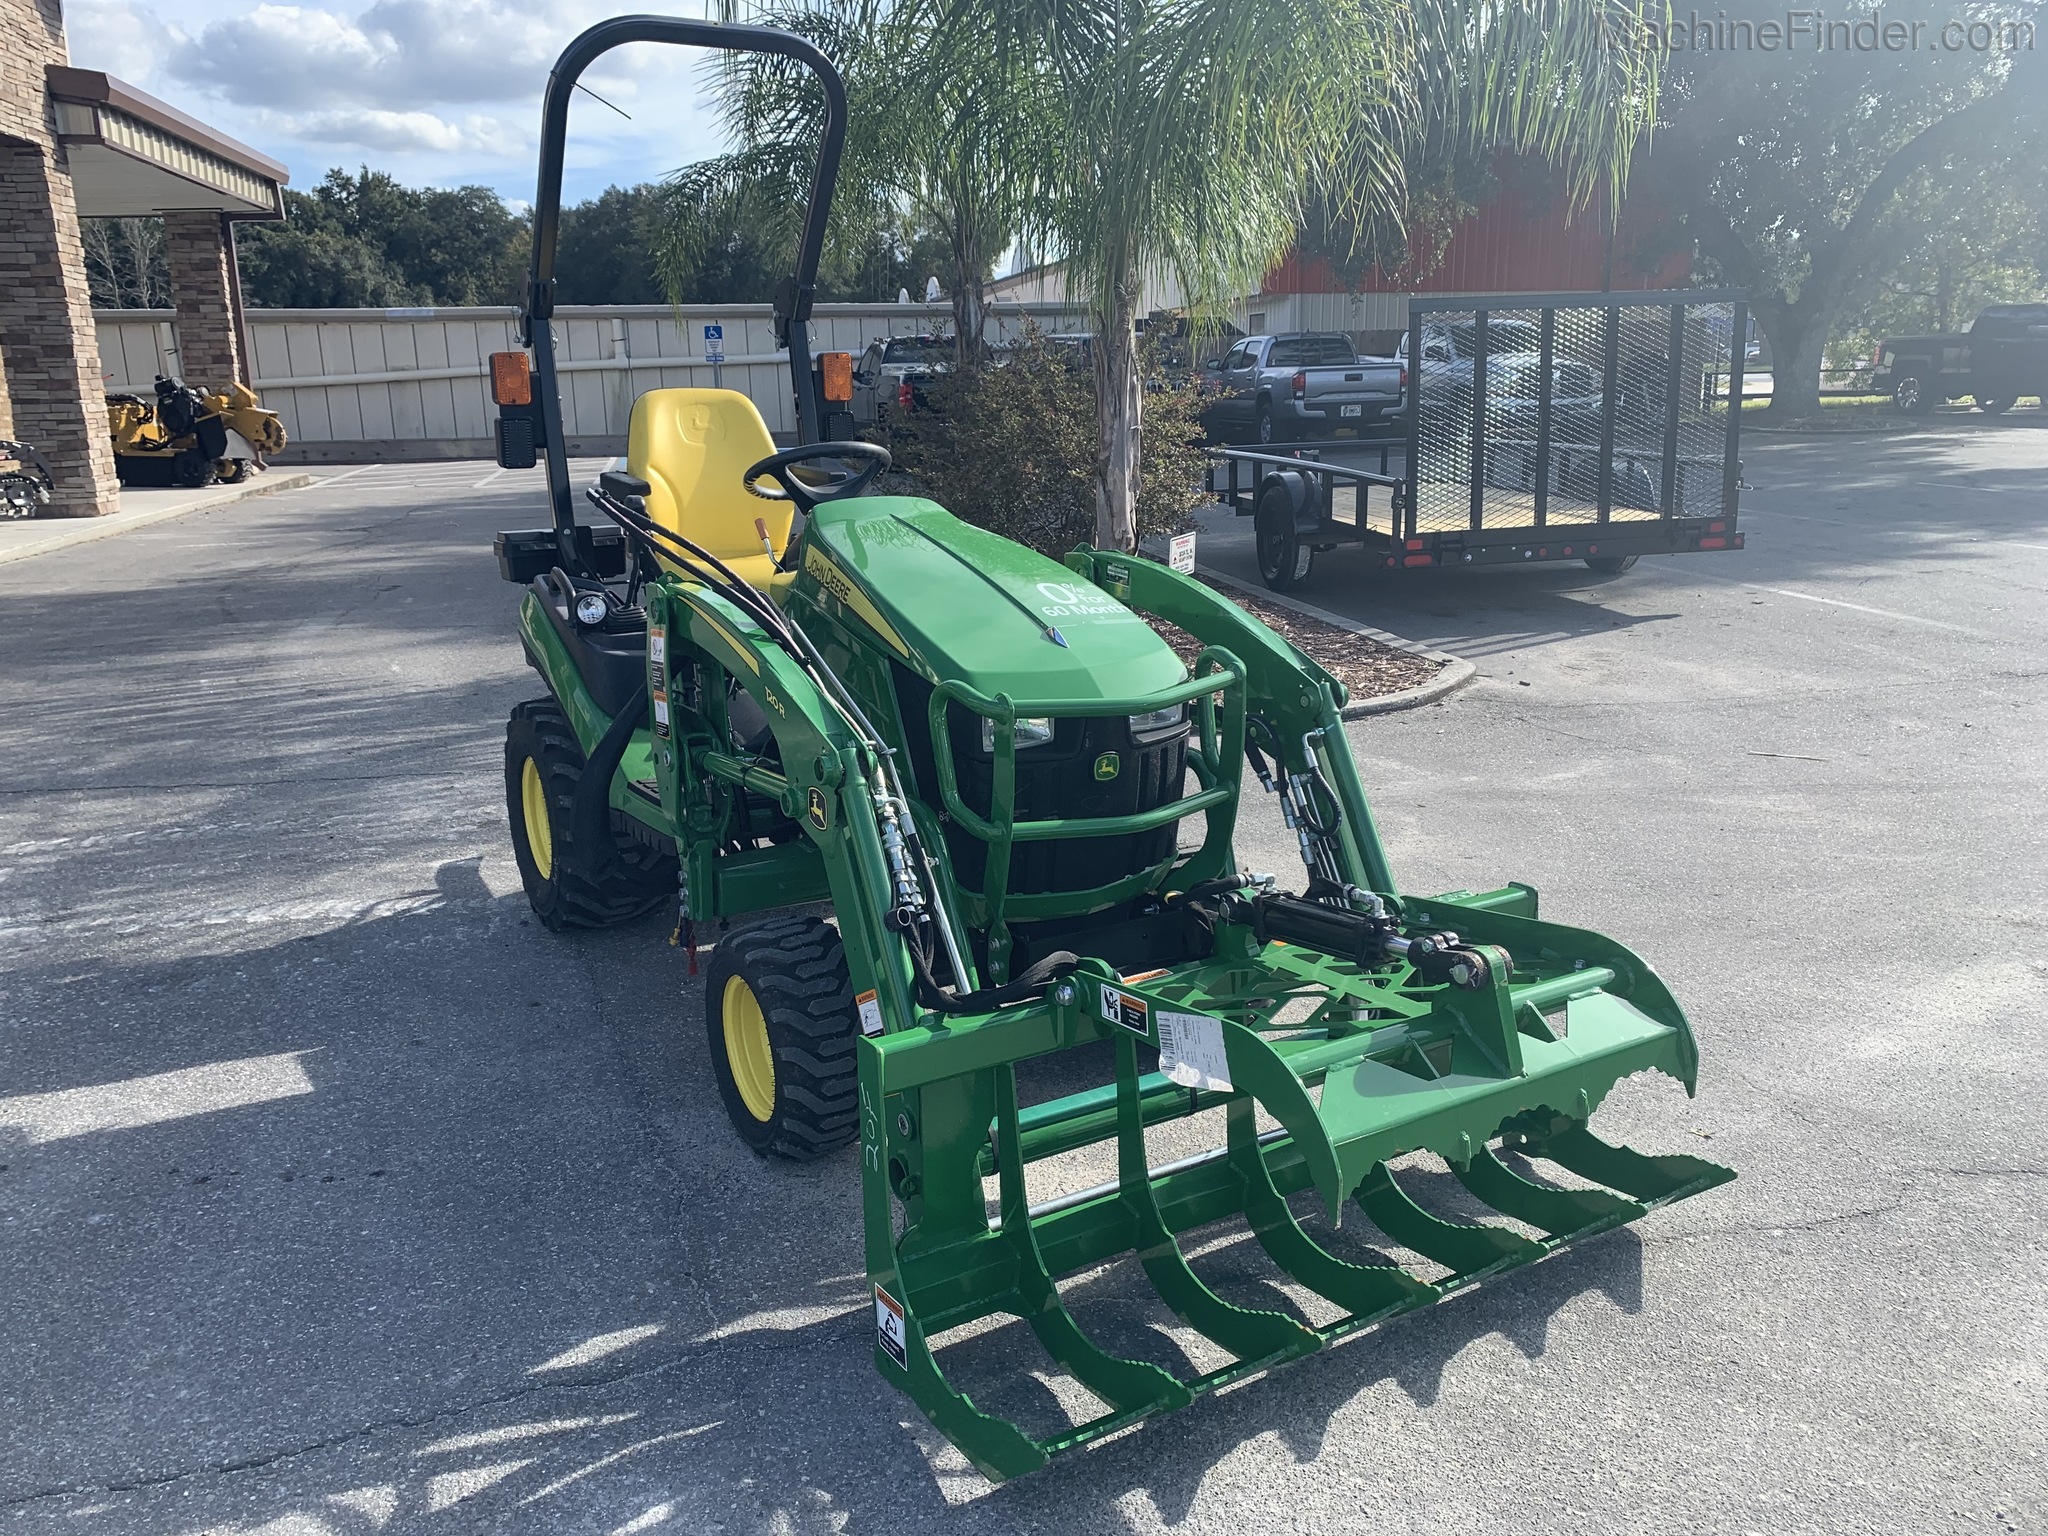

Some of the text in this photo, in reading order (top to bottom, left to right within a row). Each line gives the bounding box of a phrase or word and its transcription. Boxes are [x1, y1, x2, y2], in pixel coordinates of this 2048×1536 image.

[807, 554, 851, 604] JOHN DEERE
[1077, 592, 1106, 604] for
[1042, 605, 1070, 617] 60
